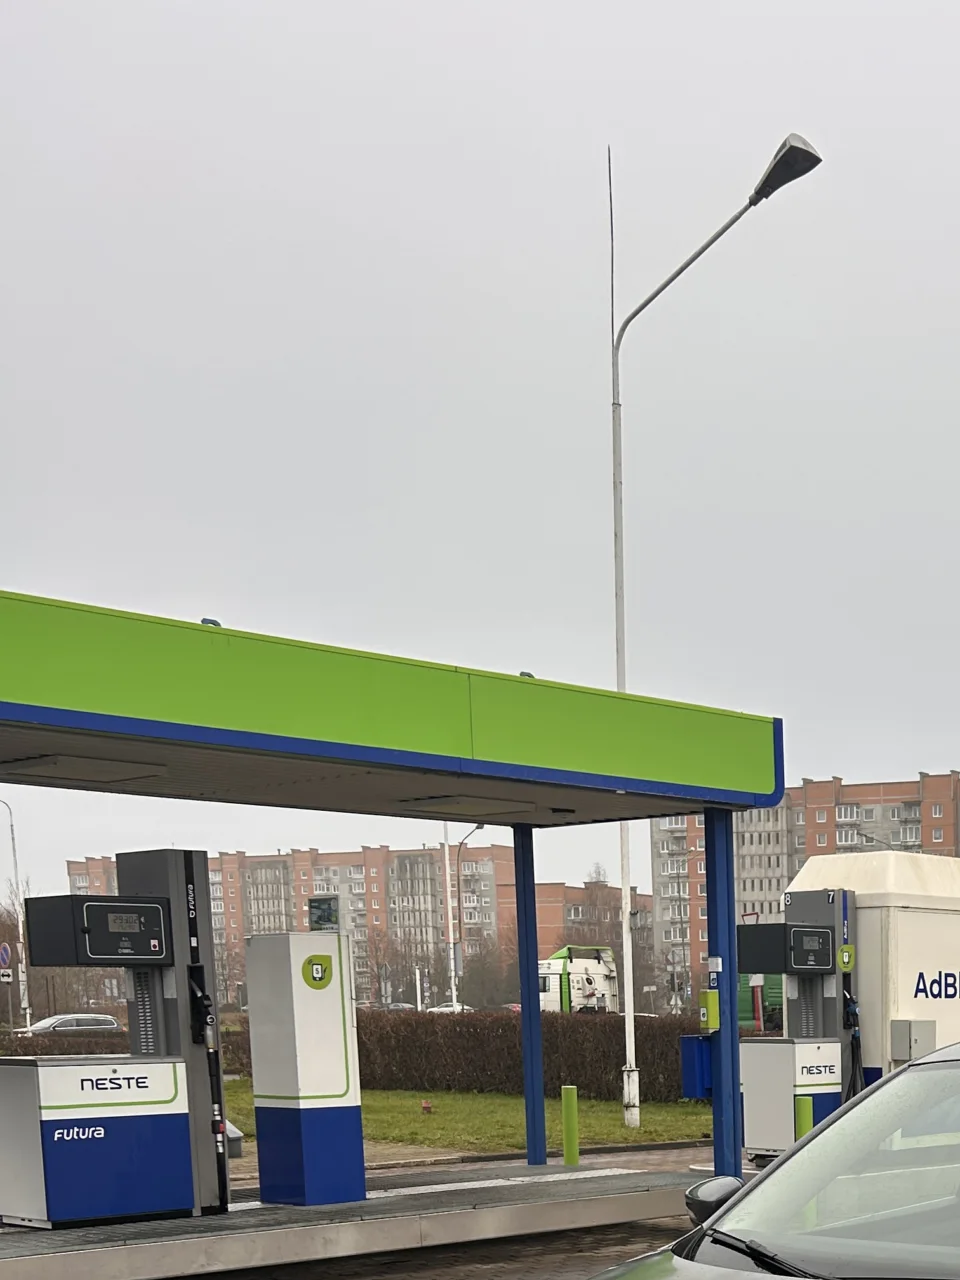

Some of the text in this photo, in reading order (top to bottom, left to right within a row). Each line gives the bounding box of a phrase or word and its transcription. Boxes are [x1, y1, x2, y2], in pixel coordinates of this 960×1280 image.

[785, 893, 792, 905] 8
[827, 892, 834, 903] 7
[801, 1064, 836, 1075] NESTE
[80, 1076, 149, 1091] NESTE
[54, 1126, 105, 1141] Futura
